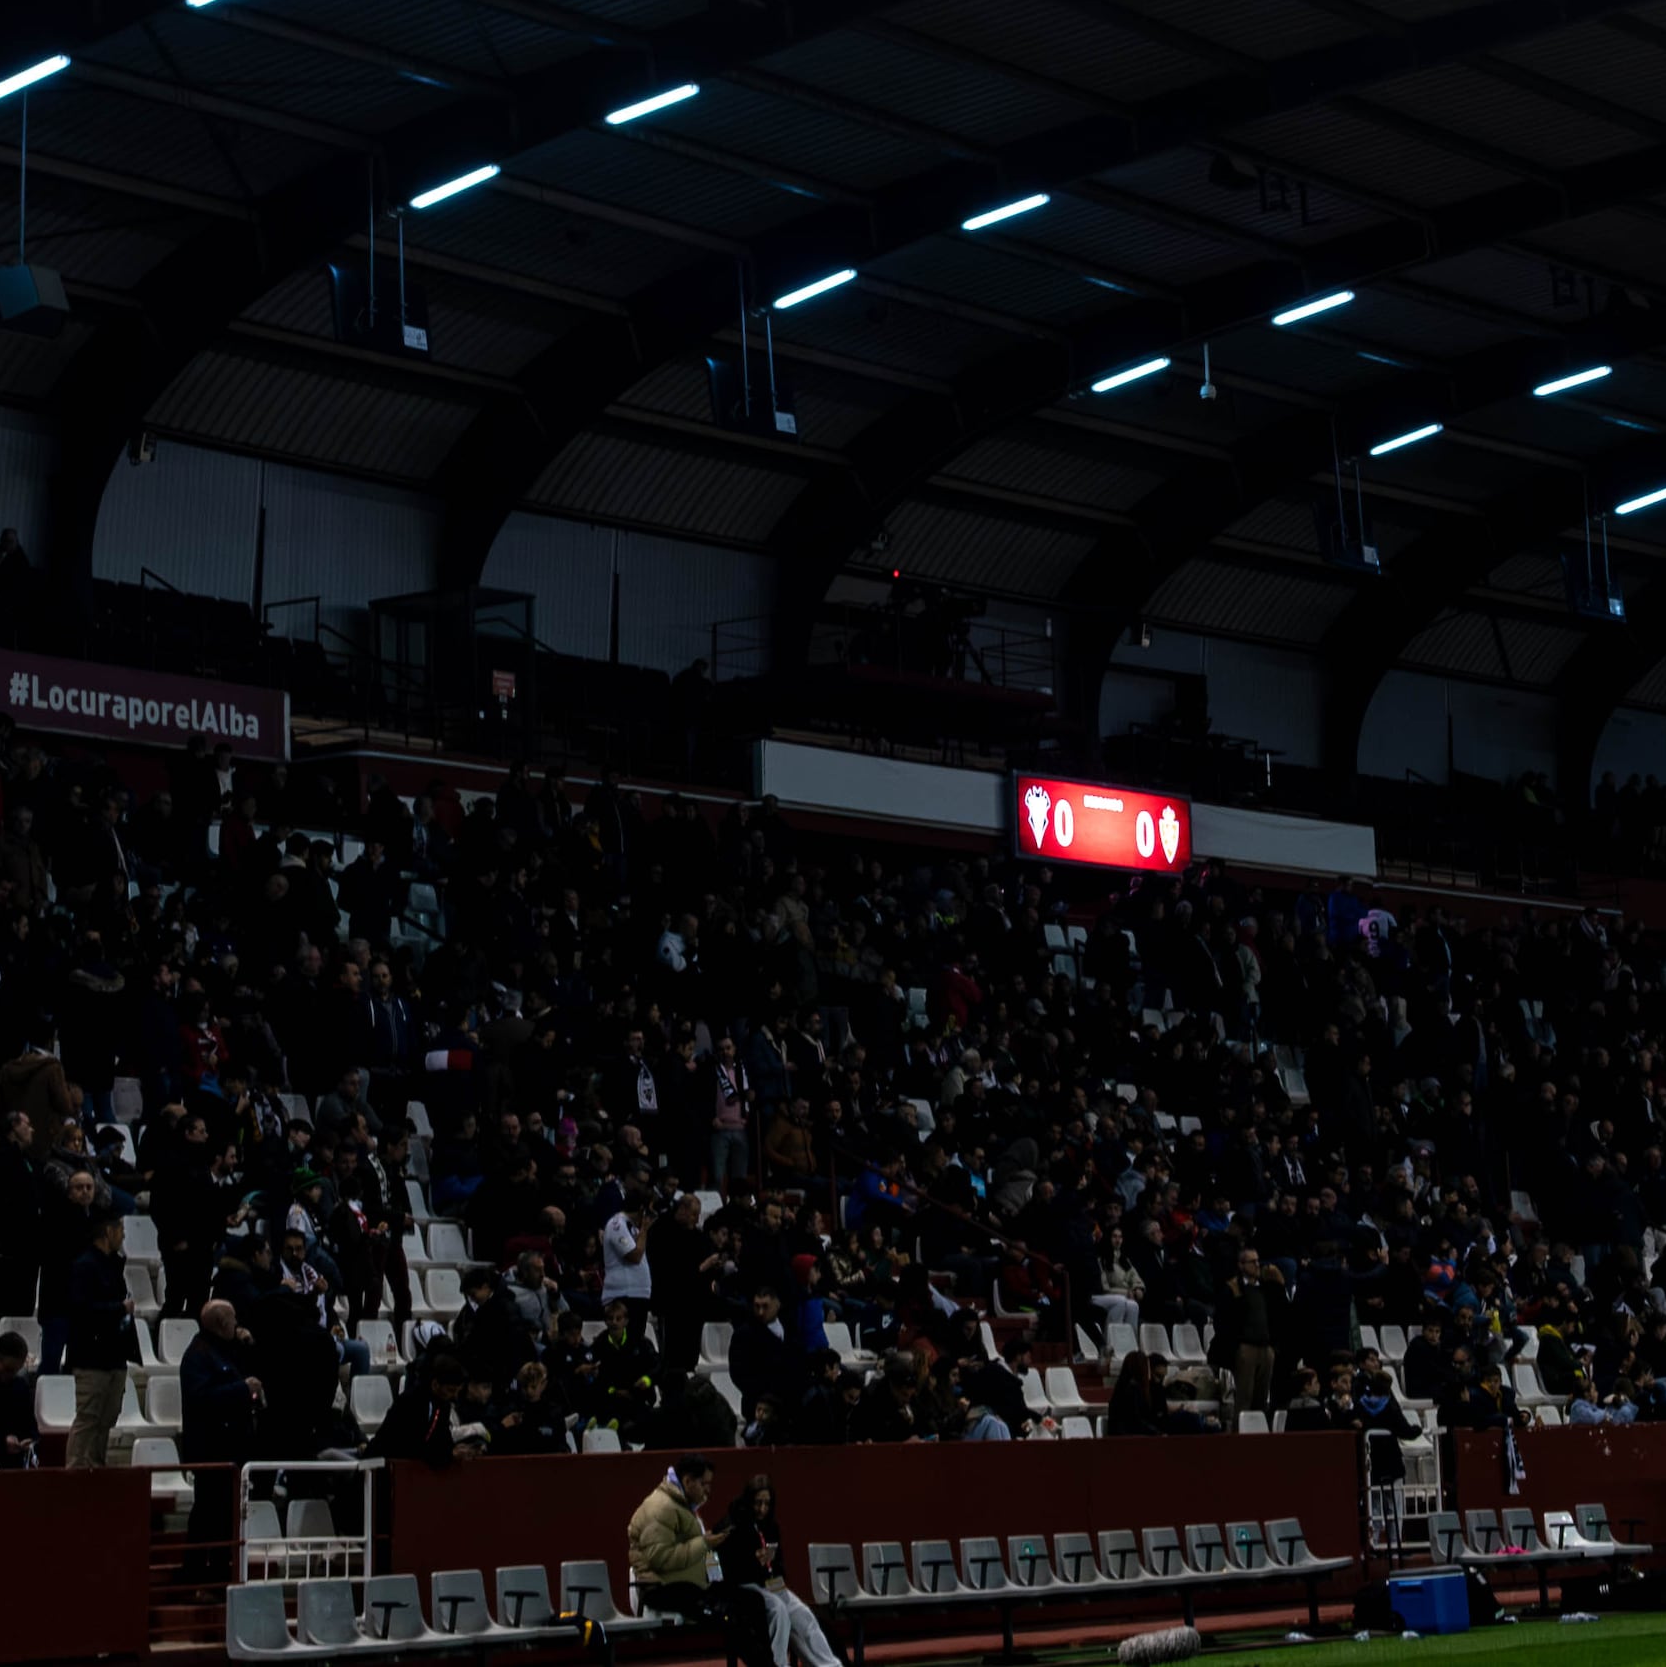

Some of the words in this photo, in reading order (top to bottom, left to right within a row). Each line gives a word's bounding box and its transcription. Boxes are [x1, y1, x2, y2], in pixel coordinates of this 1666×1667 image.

[8, 670, 260, 741] #LocuraporelAlba
[1054, 798, 1074, 847] 0
[1136, 810, 1155, 858] 0
